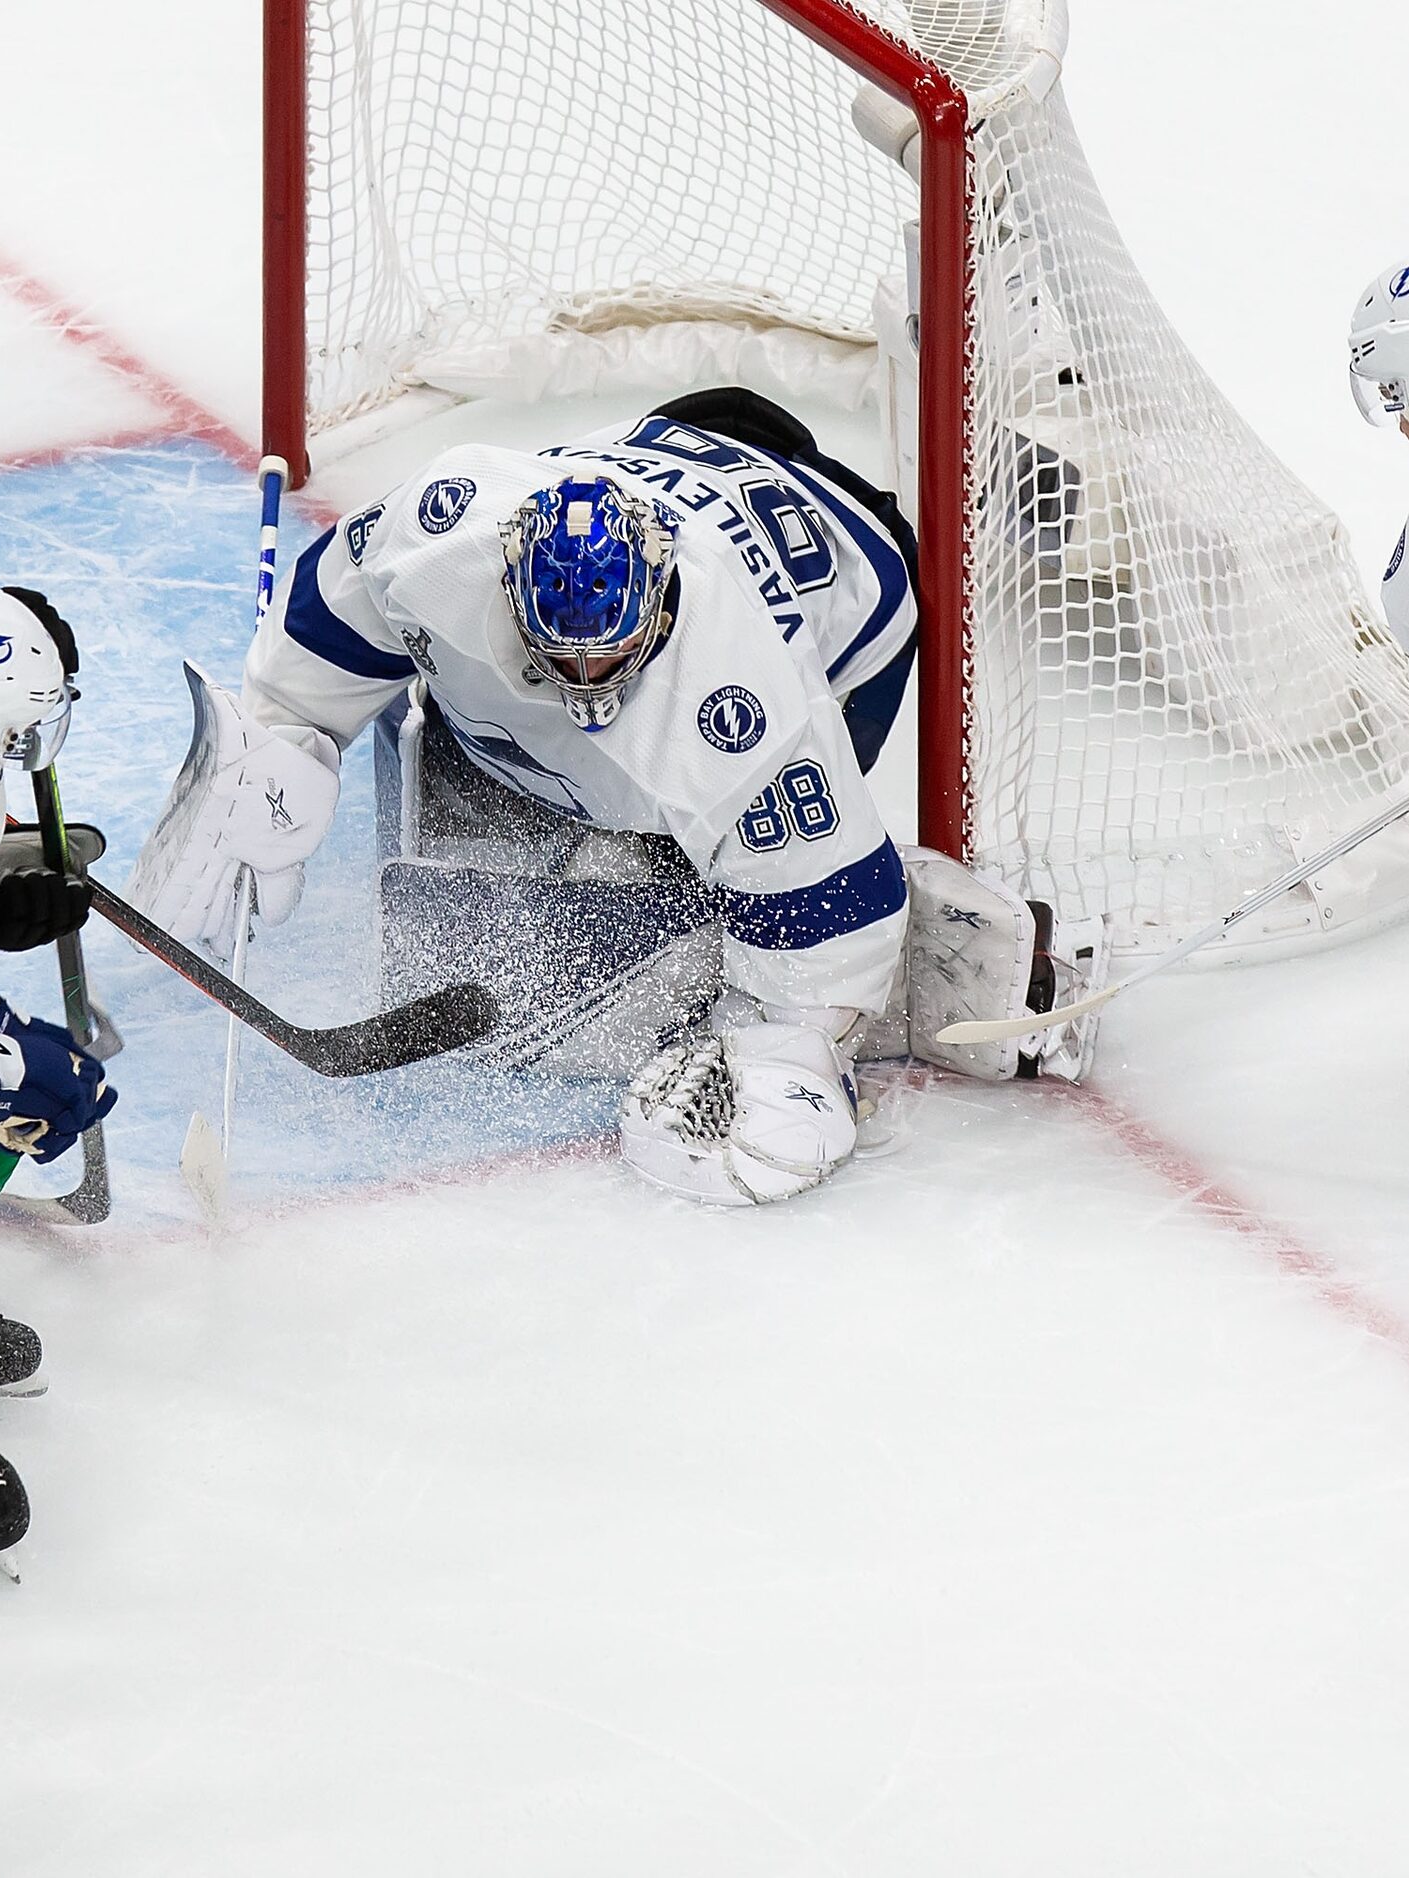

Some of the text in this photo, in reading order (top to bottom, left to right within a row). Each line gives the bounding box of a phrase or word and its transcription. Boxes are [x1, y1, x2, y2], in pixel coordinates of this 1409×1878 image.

[699, 699, 715, 720] BAY
[714, 687, 764, 720] LIGHTNING
[700, 721, 728, 751] TAMPA
[735, 757, 841, 854] 88
